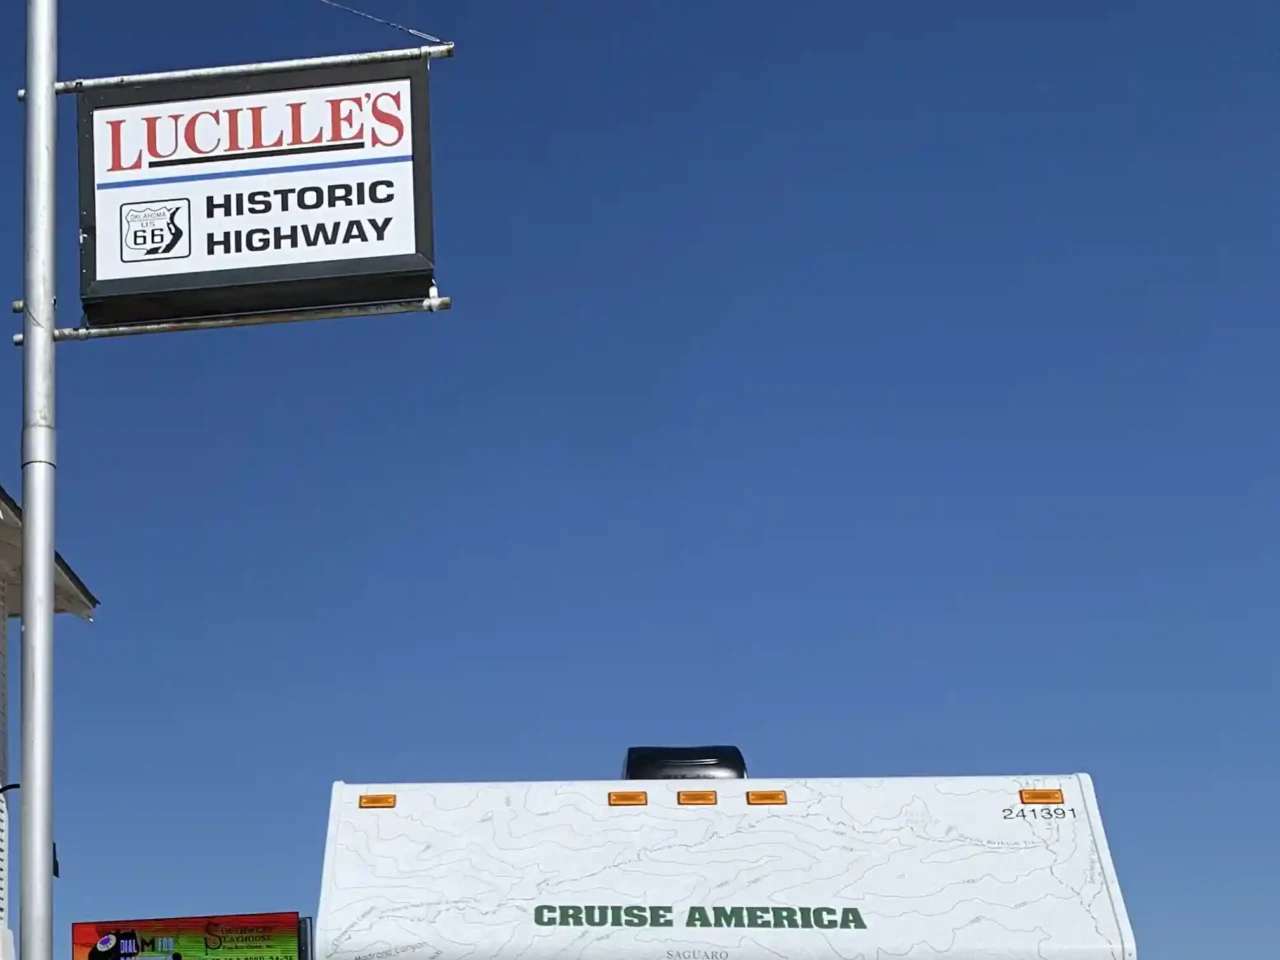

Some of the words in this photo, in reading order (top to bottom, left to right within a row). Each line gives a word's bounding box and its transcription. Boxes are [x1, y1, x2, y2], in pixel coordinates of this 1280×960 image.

[106, 91, 405, 172] LUCILLE'S
[206, 180, 395, 219] HISTORIC
[130, 212, 167, 220] OKLAHOMA
[133, 228, 164, 246] 66
[206, 217, 393, 256] HIGHWAY
[1002, 808, 1077, 820] 241391
[534, 904, 674, 928] CRUISE
[685, 905, 868, 930] AMERICA
[120, 940, 137, 954] DIAL
[141, 936, 156, 952] M
[666, 950, 729, 960] SAGUARO
